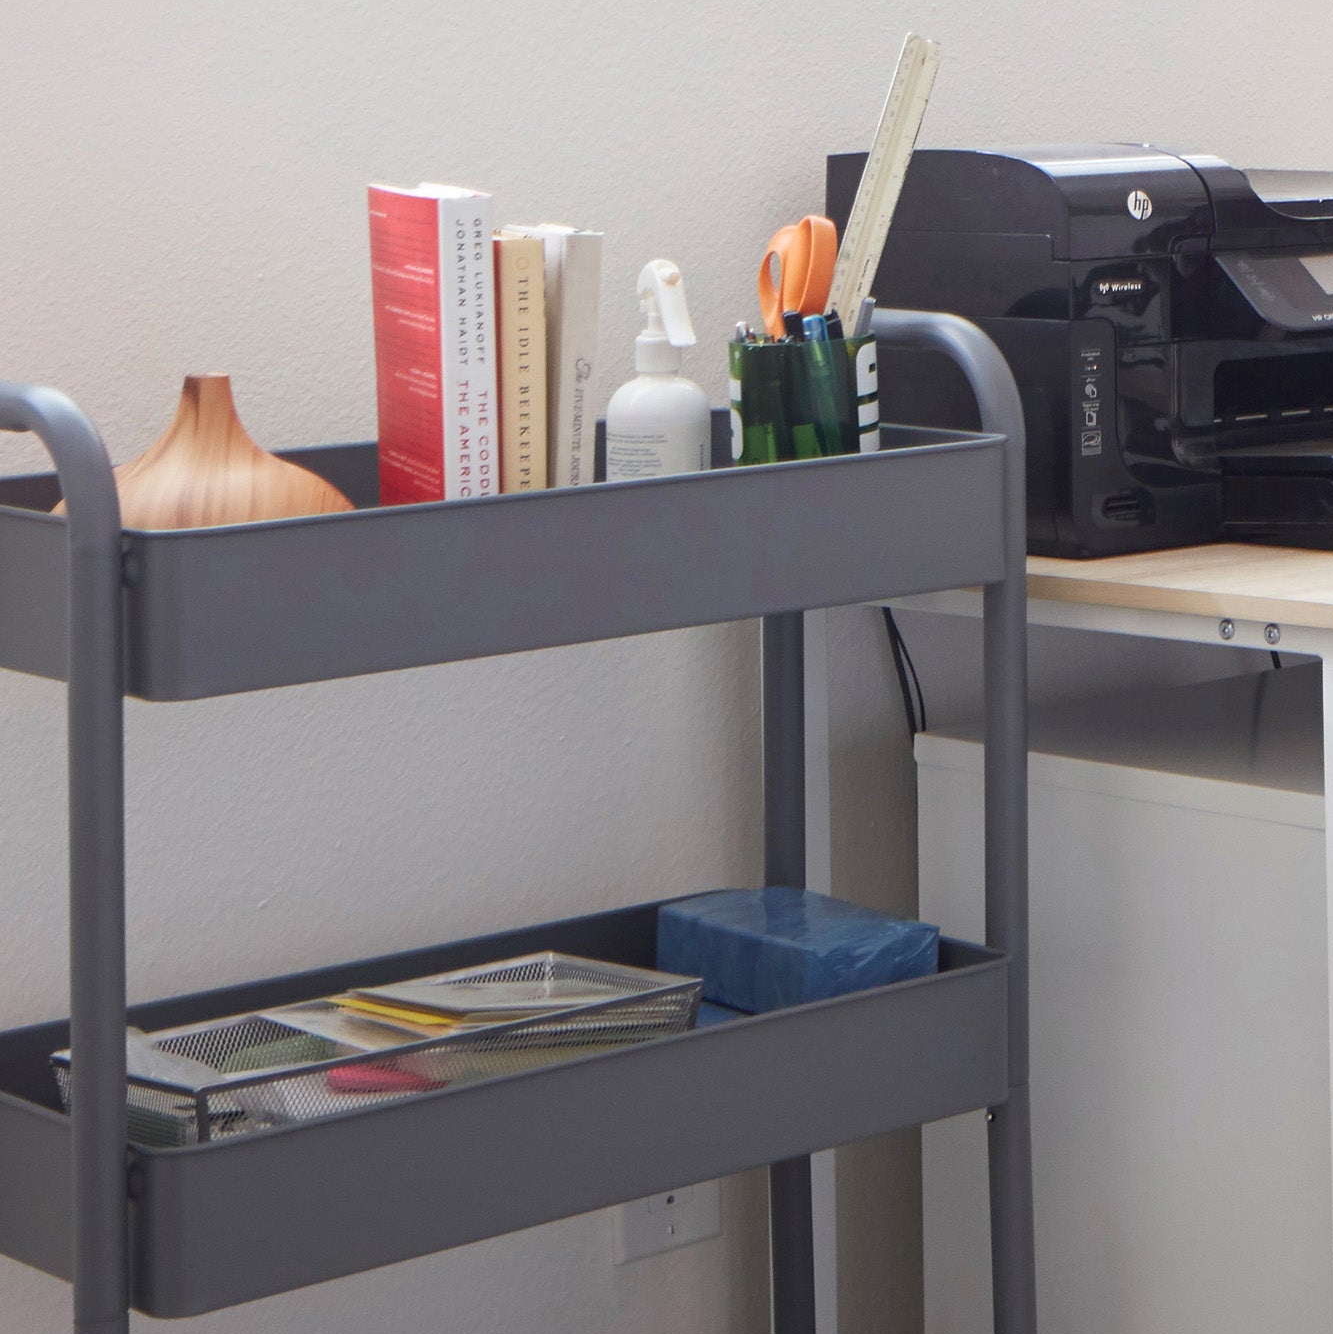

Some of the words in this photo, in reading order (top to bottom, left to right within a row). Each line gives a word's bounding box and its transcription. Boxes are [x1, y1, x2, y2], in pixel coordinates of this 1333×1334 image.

[1133, 191, 1150, 220] hp
[472, 218, 484, 261] GREG
[455, 219, 468, 308] JONATHAN
[518, 276, 530, 315] THE
[1111, 281, 1142, 292] Wireless
[474, 271, 486, 365] LUKIANOFF
[457, 317, 469, 366] HAIDT
[518, 327, 530, 375] IDLE
[575, 358, 591, 384] The
[458, 380, 469, 415] THE
[478, 391, 489, 426] THE
[519, 385, 531, 490] BEEKEEPE
[459, 425, 472, 497] AMERIC
